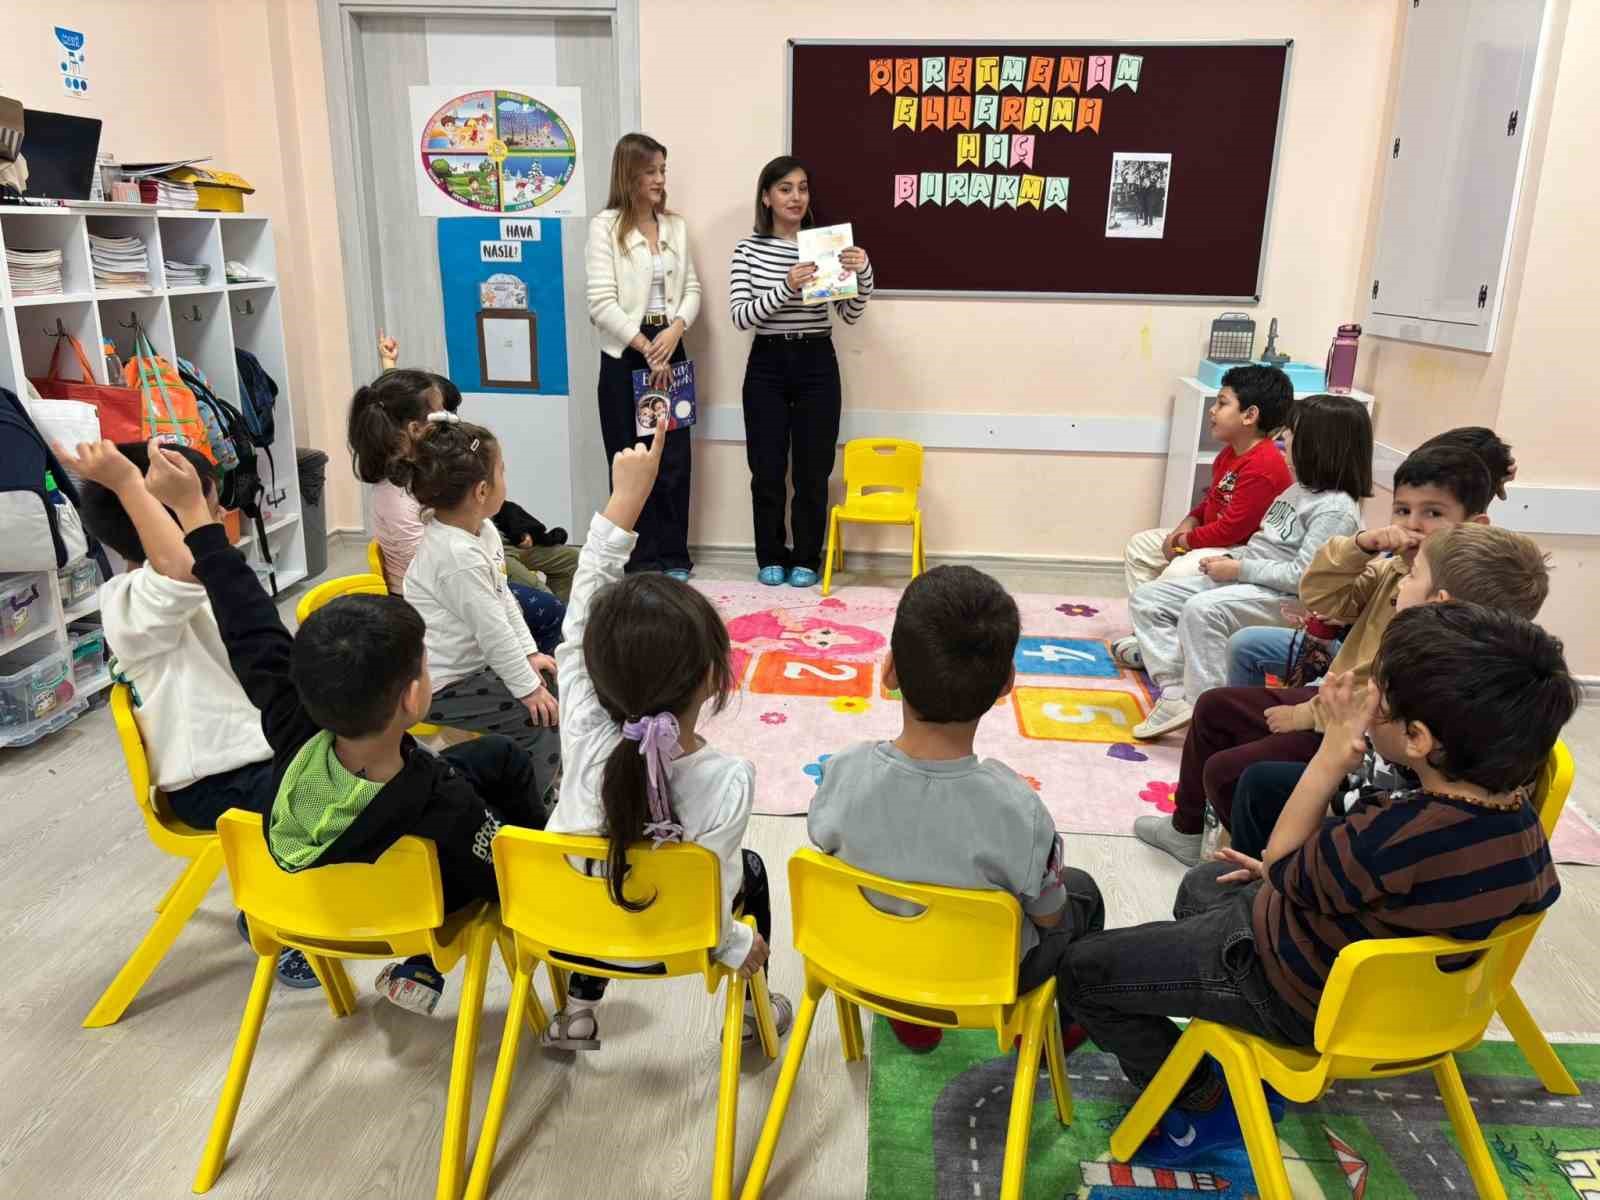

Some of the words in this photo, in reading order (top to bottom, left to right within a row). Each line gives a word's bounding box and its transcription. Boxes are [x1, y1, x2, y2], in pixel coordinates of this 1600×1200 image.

[897, 97, 1096, 124] ELLERİMİ
[959, 135, 1029, 160] HİÇ
[900, 174, 1067, 201] BIRAKMA
[506, 224, 534, 239] HAVA
[1022, 645, 1096, 662] 4
[783, 661, 858, 681] 2
[1042, 702, 1127, 727] 5
